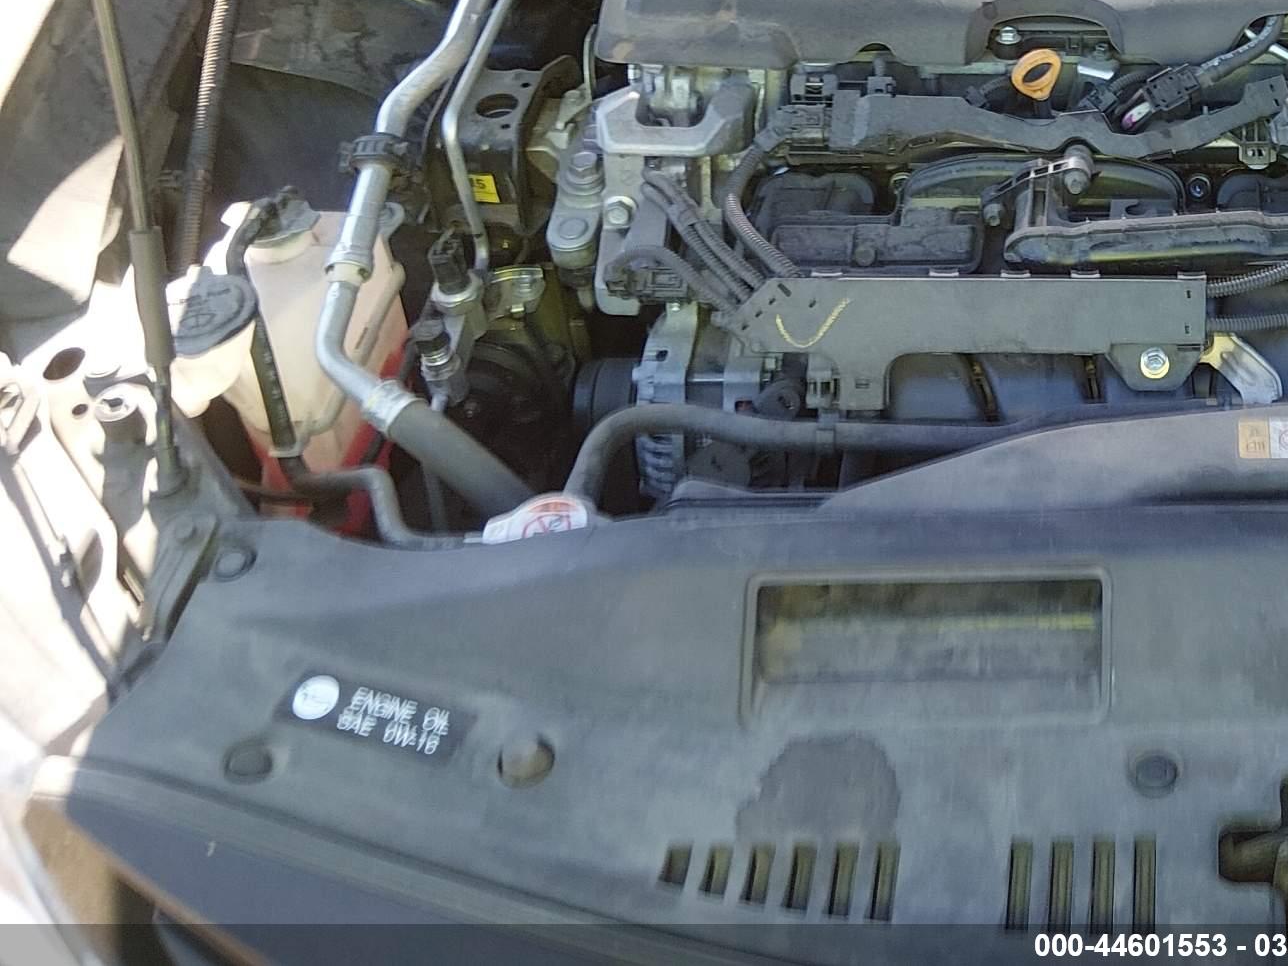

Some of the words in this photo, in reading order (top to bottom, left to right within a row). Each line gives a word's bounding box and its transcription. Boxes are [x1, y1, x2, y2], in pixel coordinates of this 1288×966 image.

[337, 708, 376, 737] SAE
[351, 687, 418, 721] ENGINE
[422, 707, 450, 736] OIL
